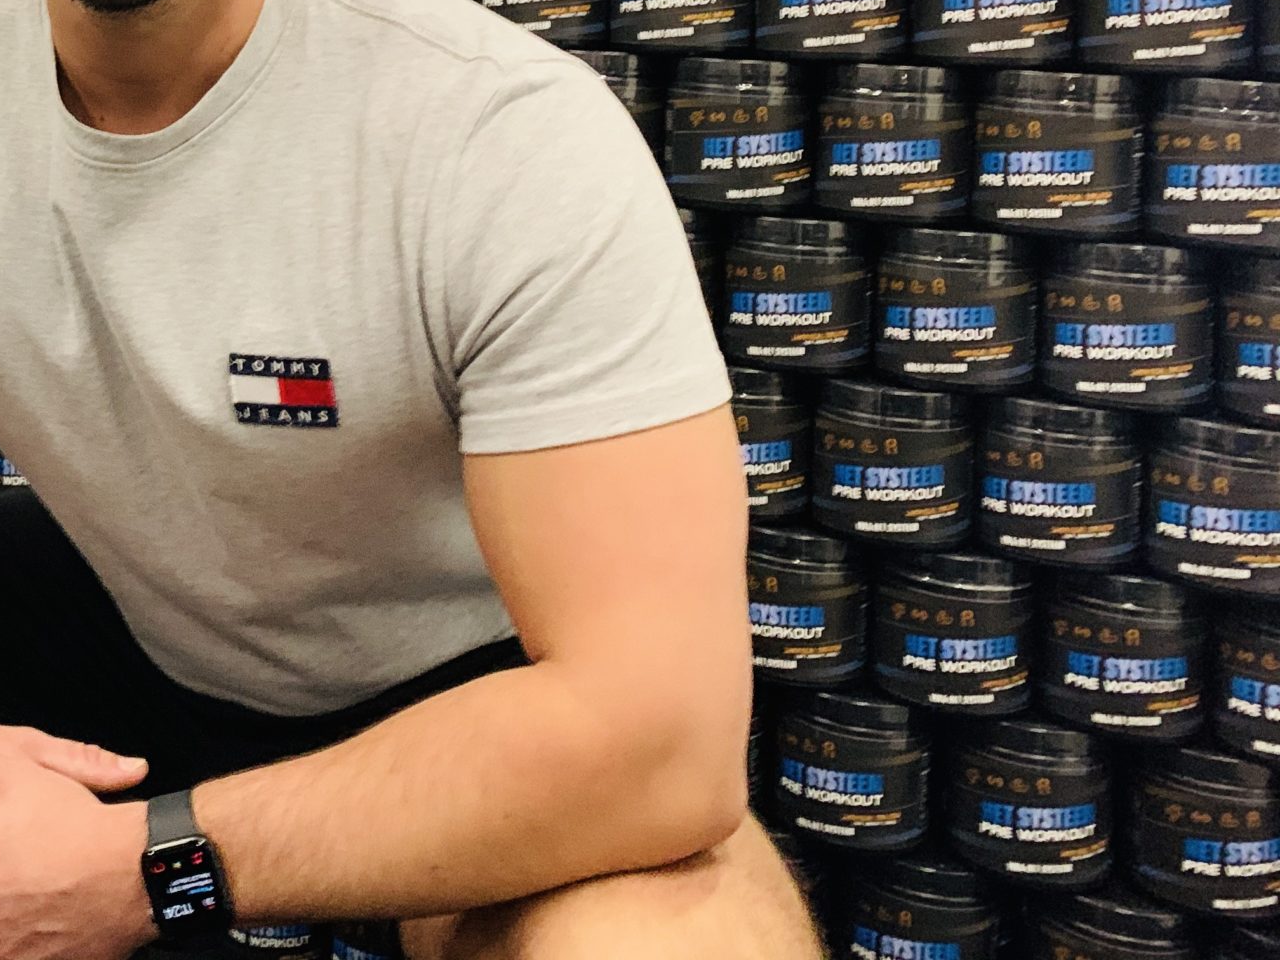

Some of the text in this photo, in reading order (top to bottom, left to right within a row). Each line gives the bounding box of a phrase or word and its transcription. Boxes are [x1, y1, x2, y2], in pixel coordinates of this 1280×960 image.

[979, 0, 1057, 20] WORKOUT
[1145, 5, 1232, 25] WORKOUT
[737, 150, 802, 168] WORKOUT
[861, 160, 940, 175] WORKOUT
[914, 326, 996, 341] WORKOUT
[1087, 343, 1175, 360] WORKOUT
[231, 358, 321, 376] TOMMY
[236, 407, 329, 423] JEANS
[865, 485, 944, 501] WORKOUT
[940, 656, 1016, 673] WORKOUT
[1103, 678, 1187, 693] WORKOUT
[1016, 825, 1095, 842] WORKOUT
[249, 934, 310, 947] WORKOUT
